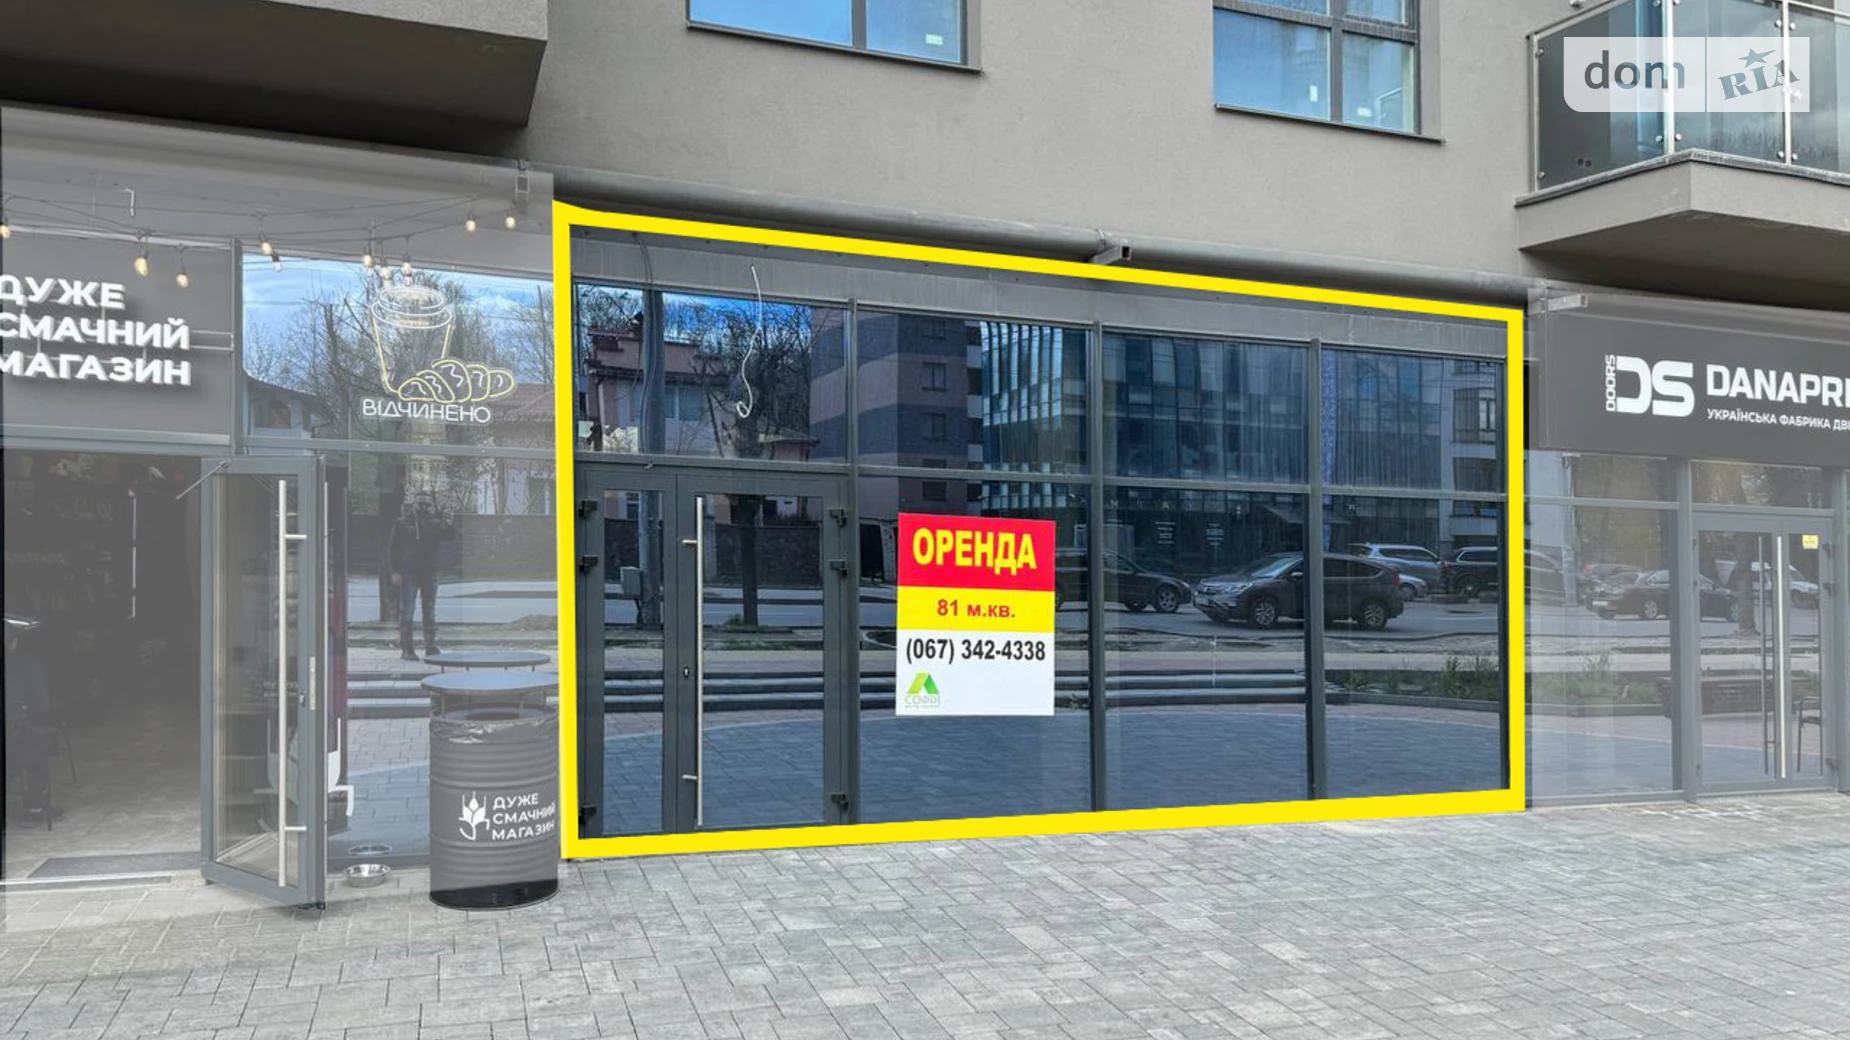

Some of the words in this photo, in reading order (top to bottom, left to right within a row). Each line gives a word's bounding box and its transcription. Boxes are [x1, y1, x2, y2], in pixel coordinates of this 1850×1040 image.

[0, 275, 126, 310] ДУЖЕ
[0, 312, 190, 350] СМАЧНИЙ
[0, 350, 191, 385] МАГАЗИН
[1605, 354, 1616, 412] DOORS
[1616, 355, 1695, 417] DS
[362, 398, 491, 423] ВІДЧИНЕНО
[1707, 407, 1777, 425] УКРАЇНСЬКА
[1779, 414, 1831, 429] ФАБРИКА
[912, 527, 1037, 576] ОРЕНДА
[937, 598, 958, 617] 81
[967, 604, 1015, 618] м.кв.
[906, 638, 955, 665] (067)
[961, 638, 1046, 661] 342-4338
[492, 792, 539, 811] ДУЖЕ
[492, 802, 556, 825] СМАЧНИЙ
[492, 819, 555, 840] МАГАЗИН
